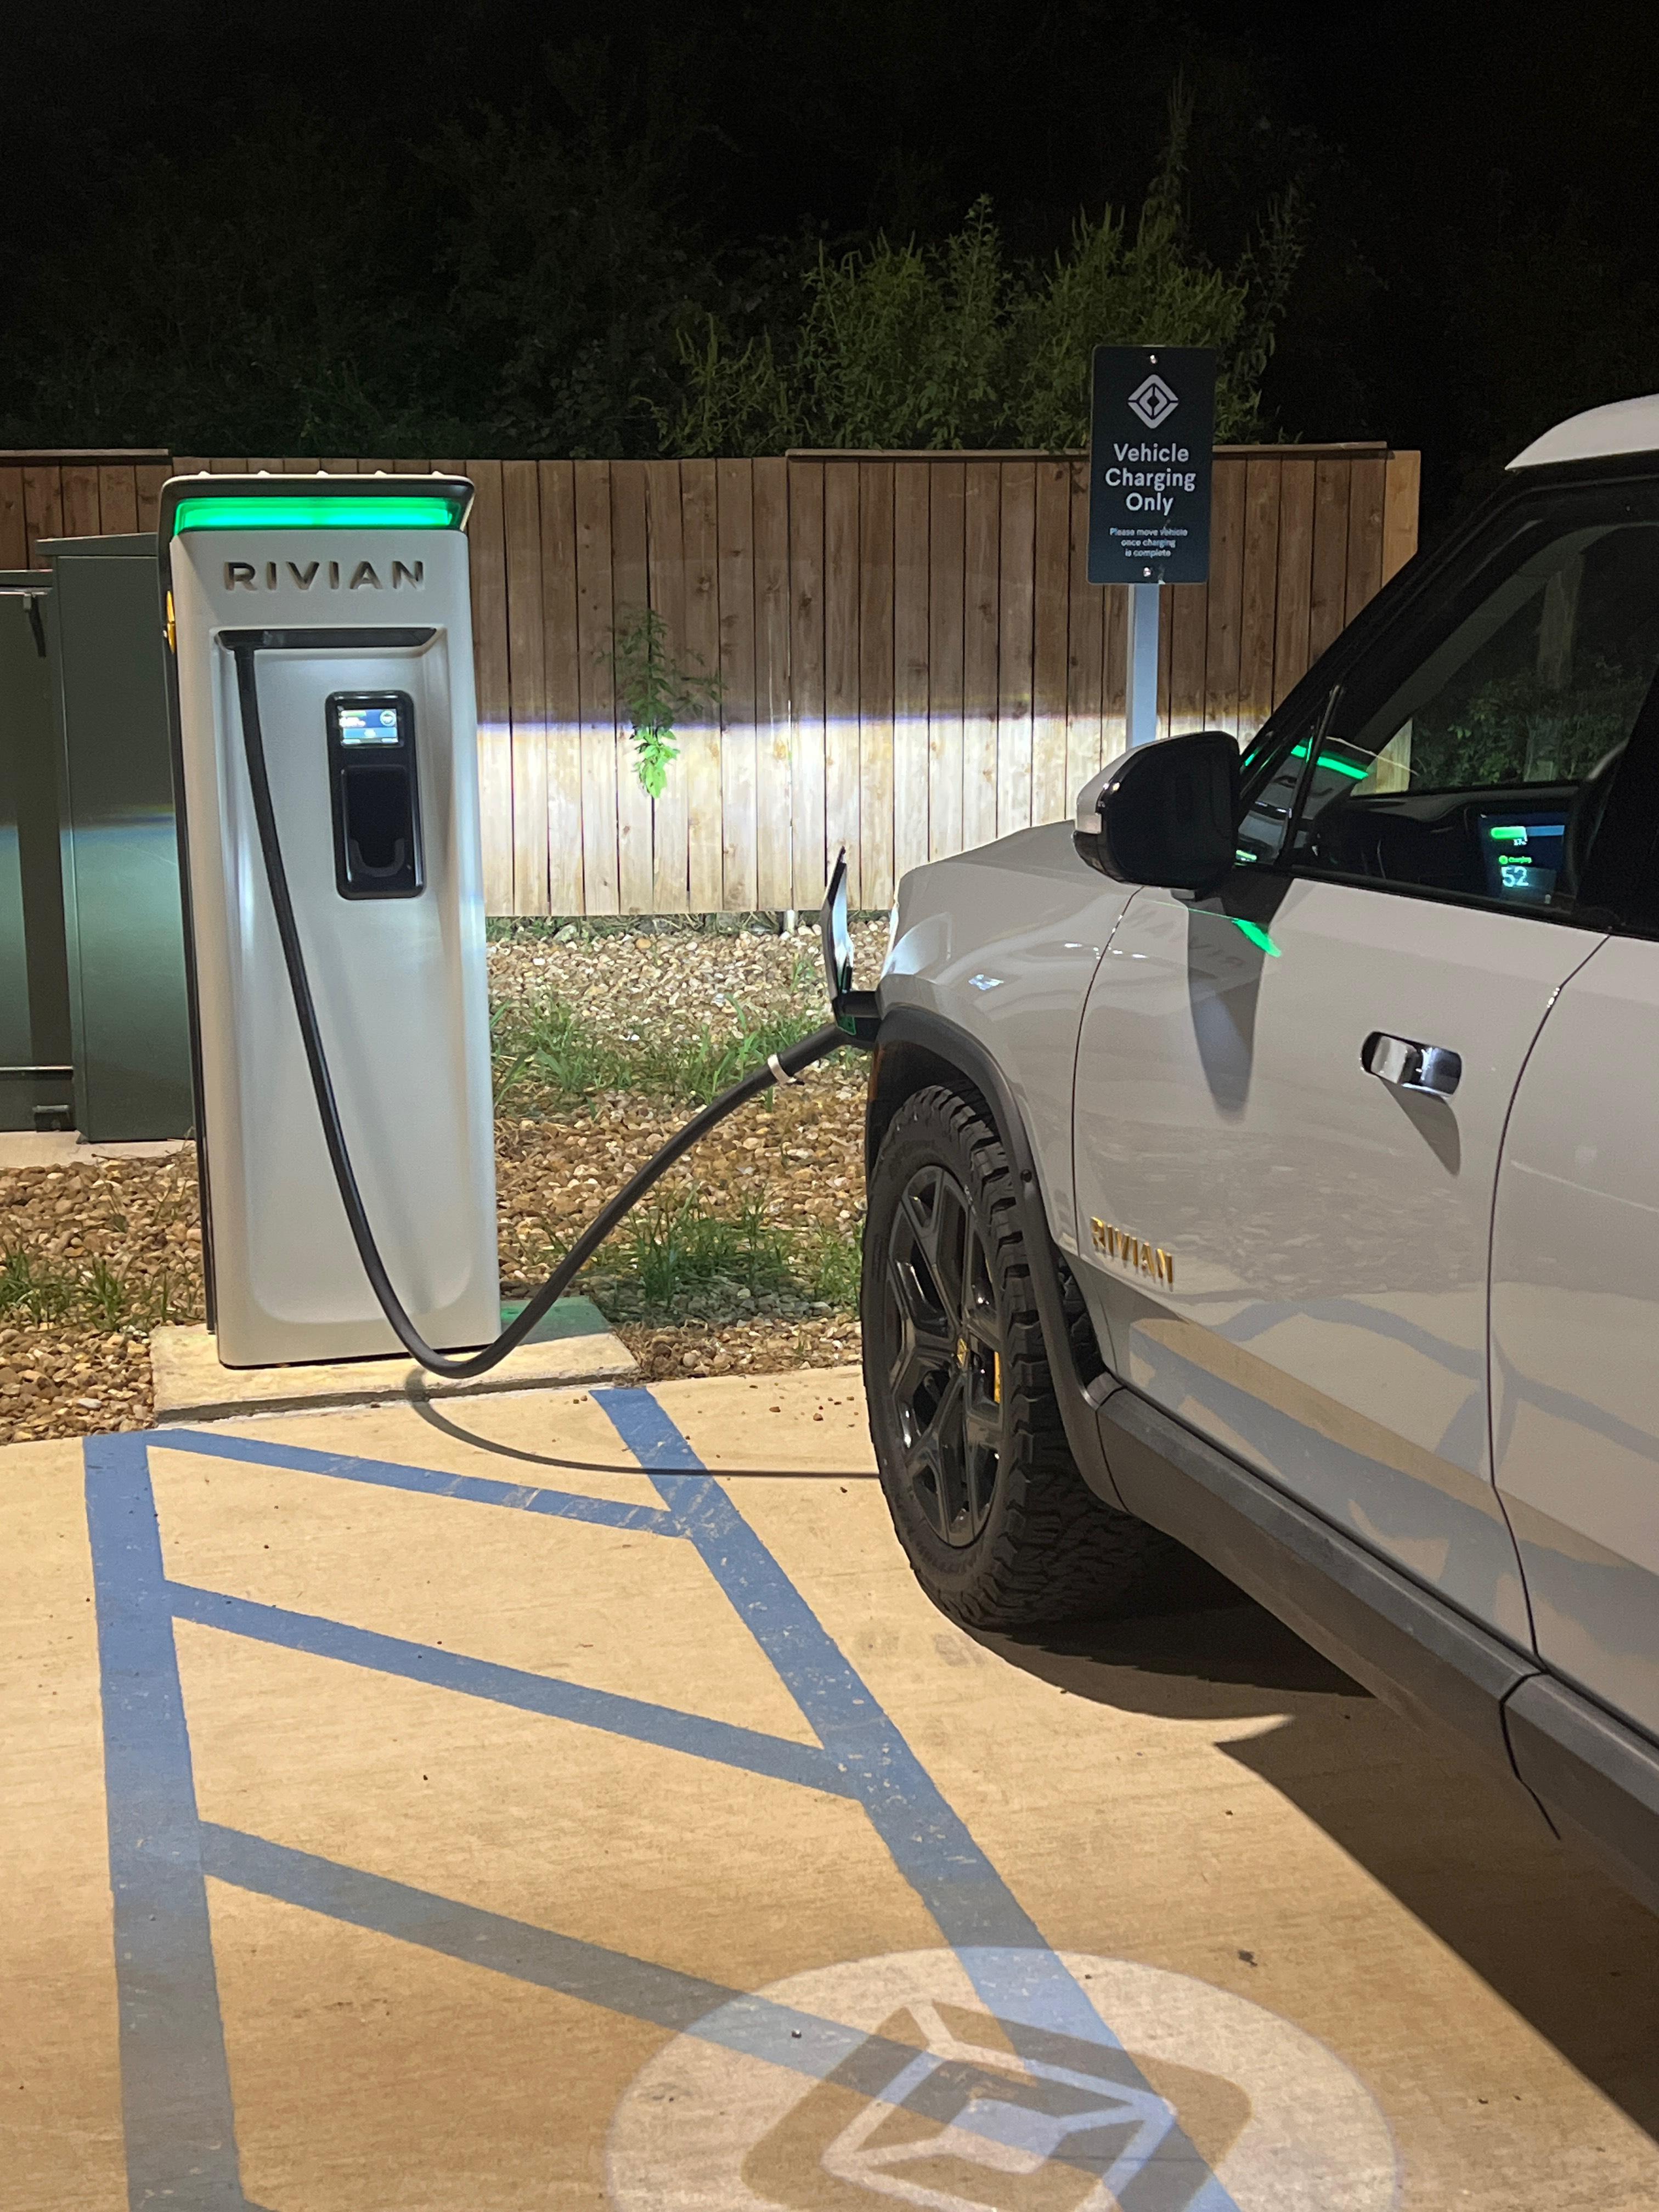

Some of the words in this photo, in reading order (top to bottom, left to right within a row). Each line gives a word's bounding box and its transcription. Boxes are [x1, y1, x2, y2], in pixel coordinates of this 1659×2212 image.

[1114, 443, 1189, 462] Vehicle
[1105, 468, 1196, 492] Charging
[1126, 492, 1173, 516] Only
[1109, 527, 1135, 536] Please
[1125, 549, 1132, 557] is
[1133, 549, 1171, 558] complete
[1142, 539, 1176, 548] charging
[223, 560, 425, 591] RIVIAN
[1501, 866, 1529, 888] 52
[1090, 1216, 1173, 1285] RIVIAN
